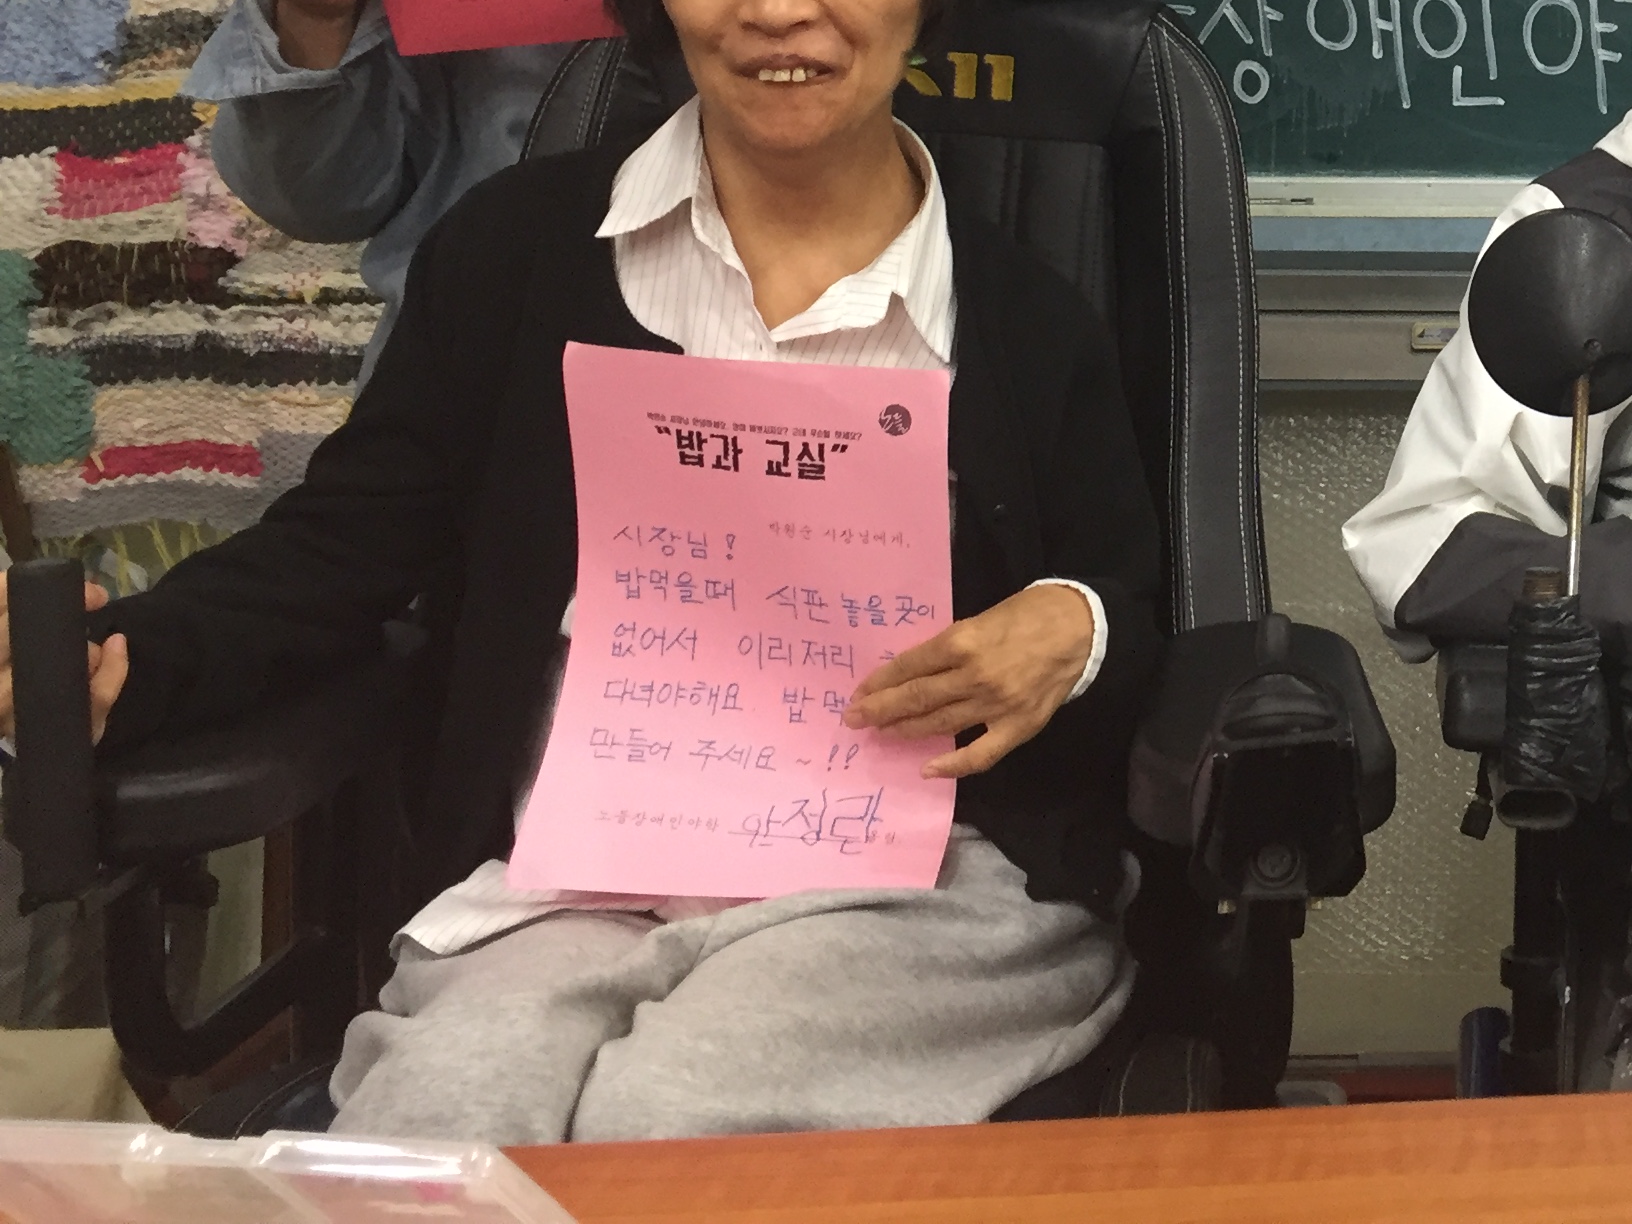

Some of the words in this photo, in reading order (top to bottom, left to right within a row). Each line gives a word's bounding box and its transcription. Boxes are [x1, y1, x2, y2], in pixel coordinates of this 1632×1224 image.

[765, 584, 830, 625] 식판
[611, 621, 699, 662] 없어서
[737, 631, 856, 679] 이리저리
[589, 727, 673, 763] 만들어
[688, 739, 777, 772] 주세요
